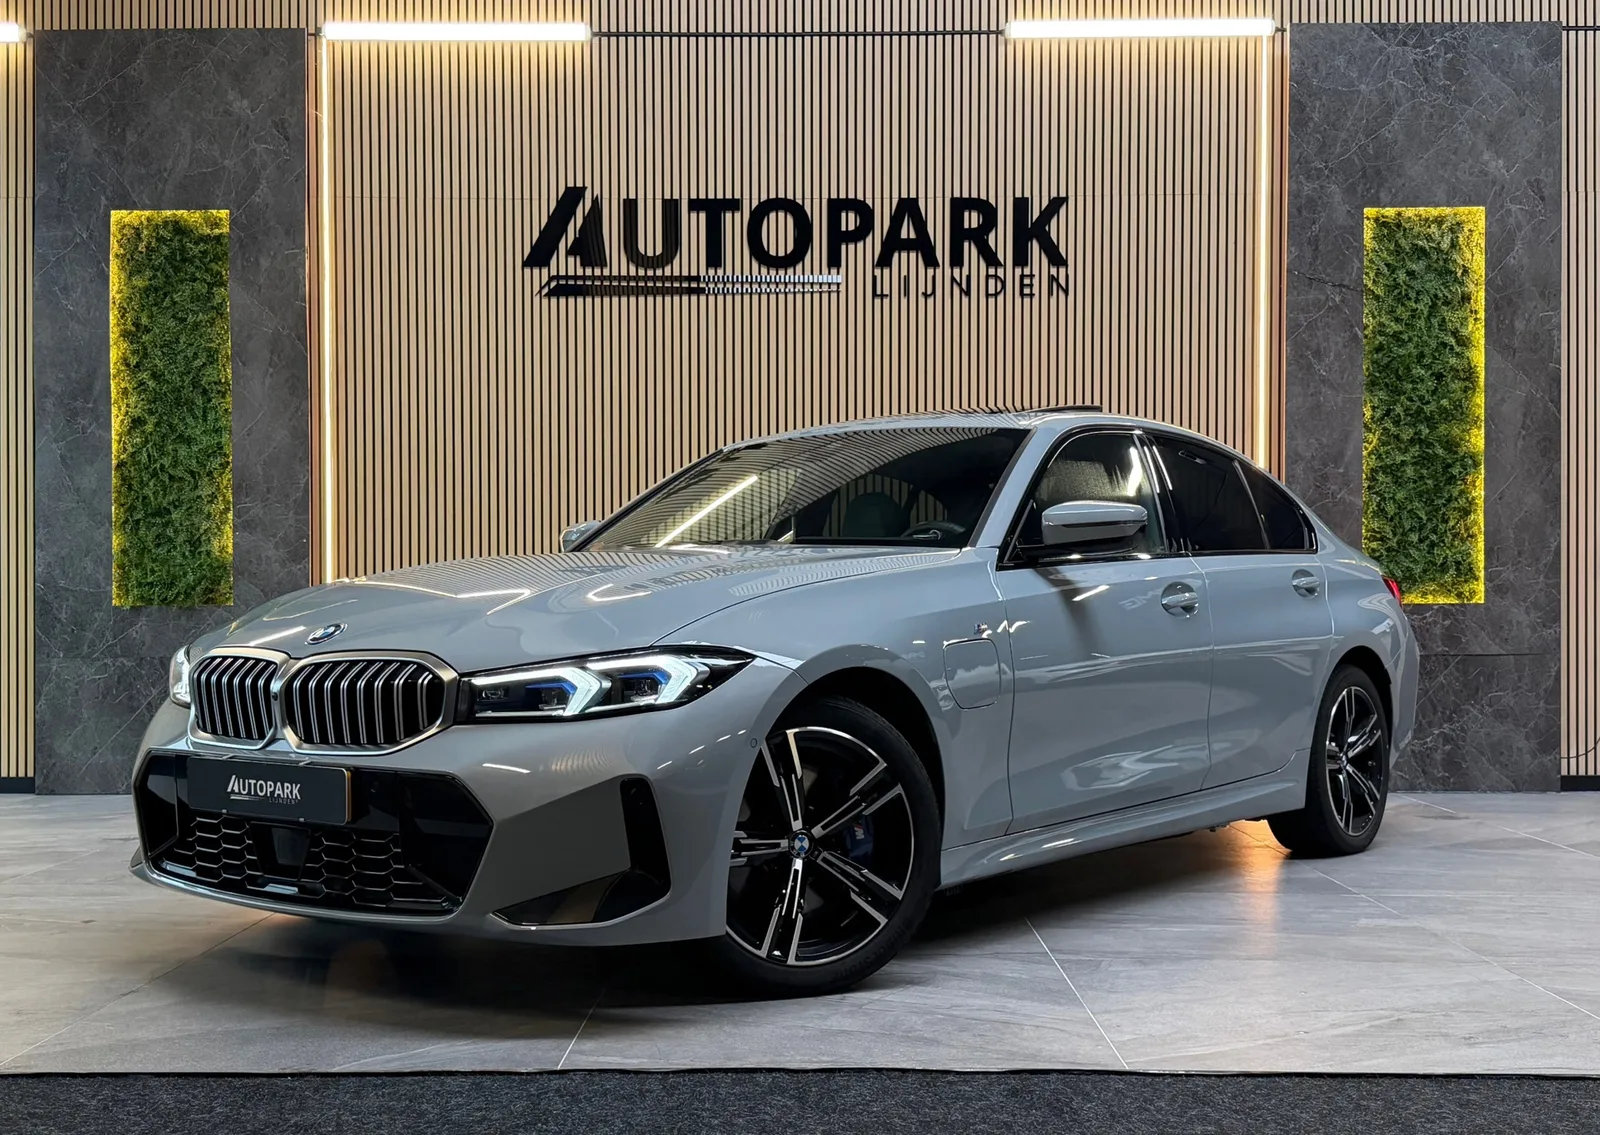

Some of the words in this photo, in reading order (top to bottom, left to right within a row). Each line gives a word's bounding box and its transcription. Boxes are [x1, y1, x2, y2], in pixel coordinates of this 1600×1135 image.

[522, 186, 1069, 269] AUTOPARK
[874, 274, 1069, 298] LIJNDEN
[227, 774, 301, 800] AUTOPARK
